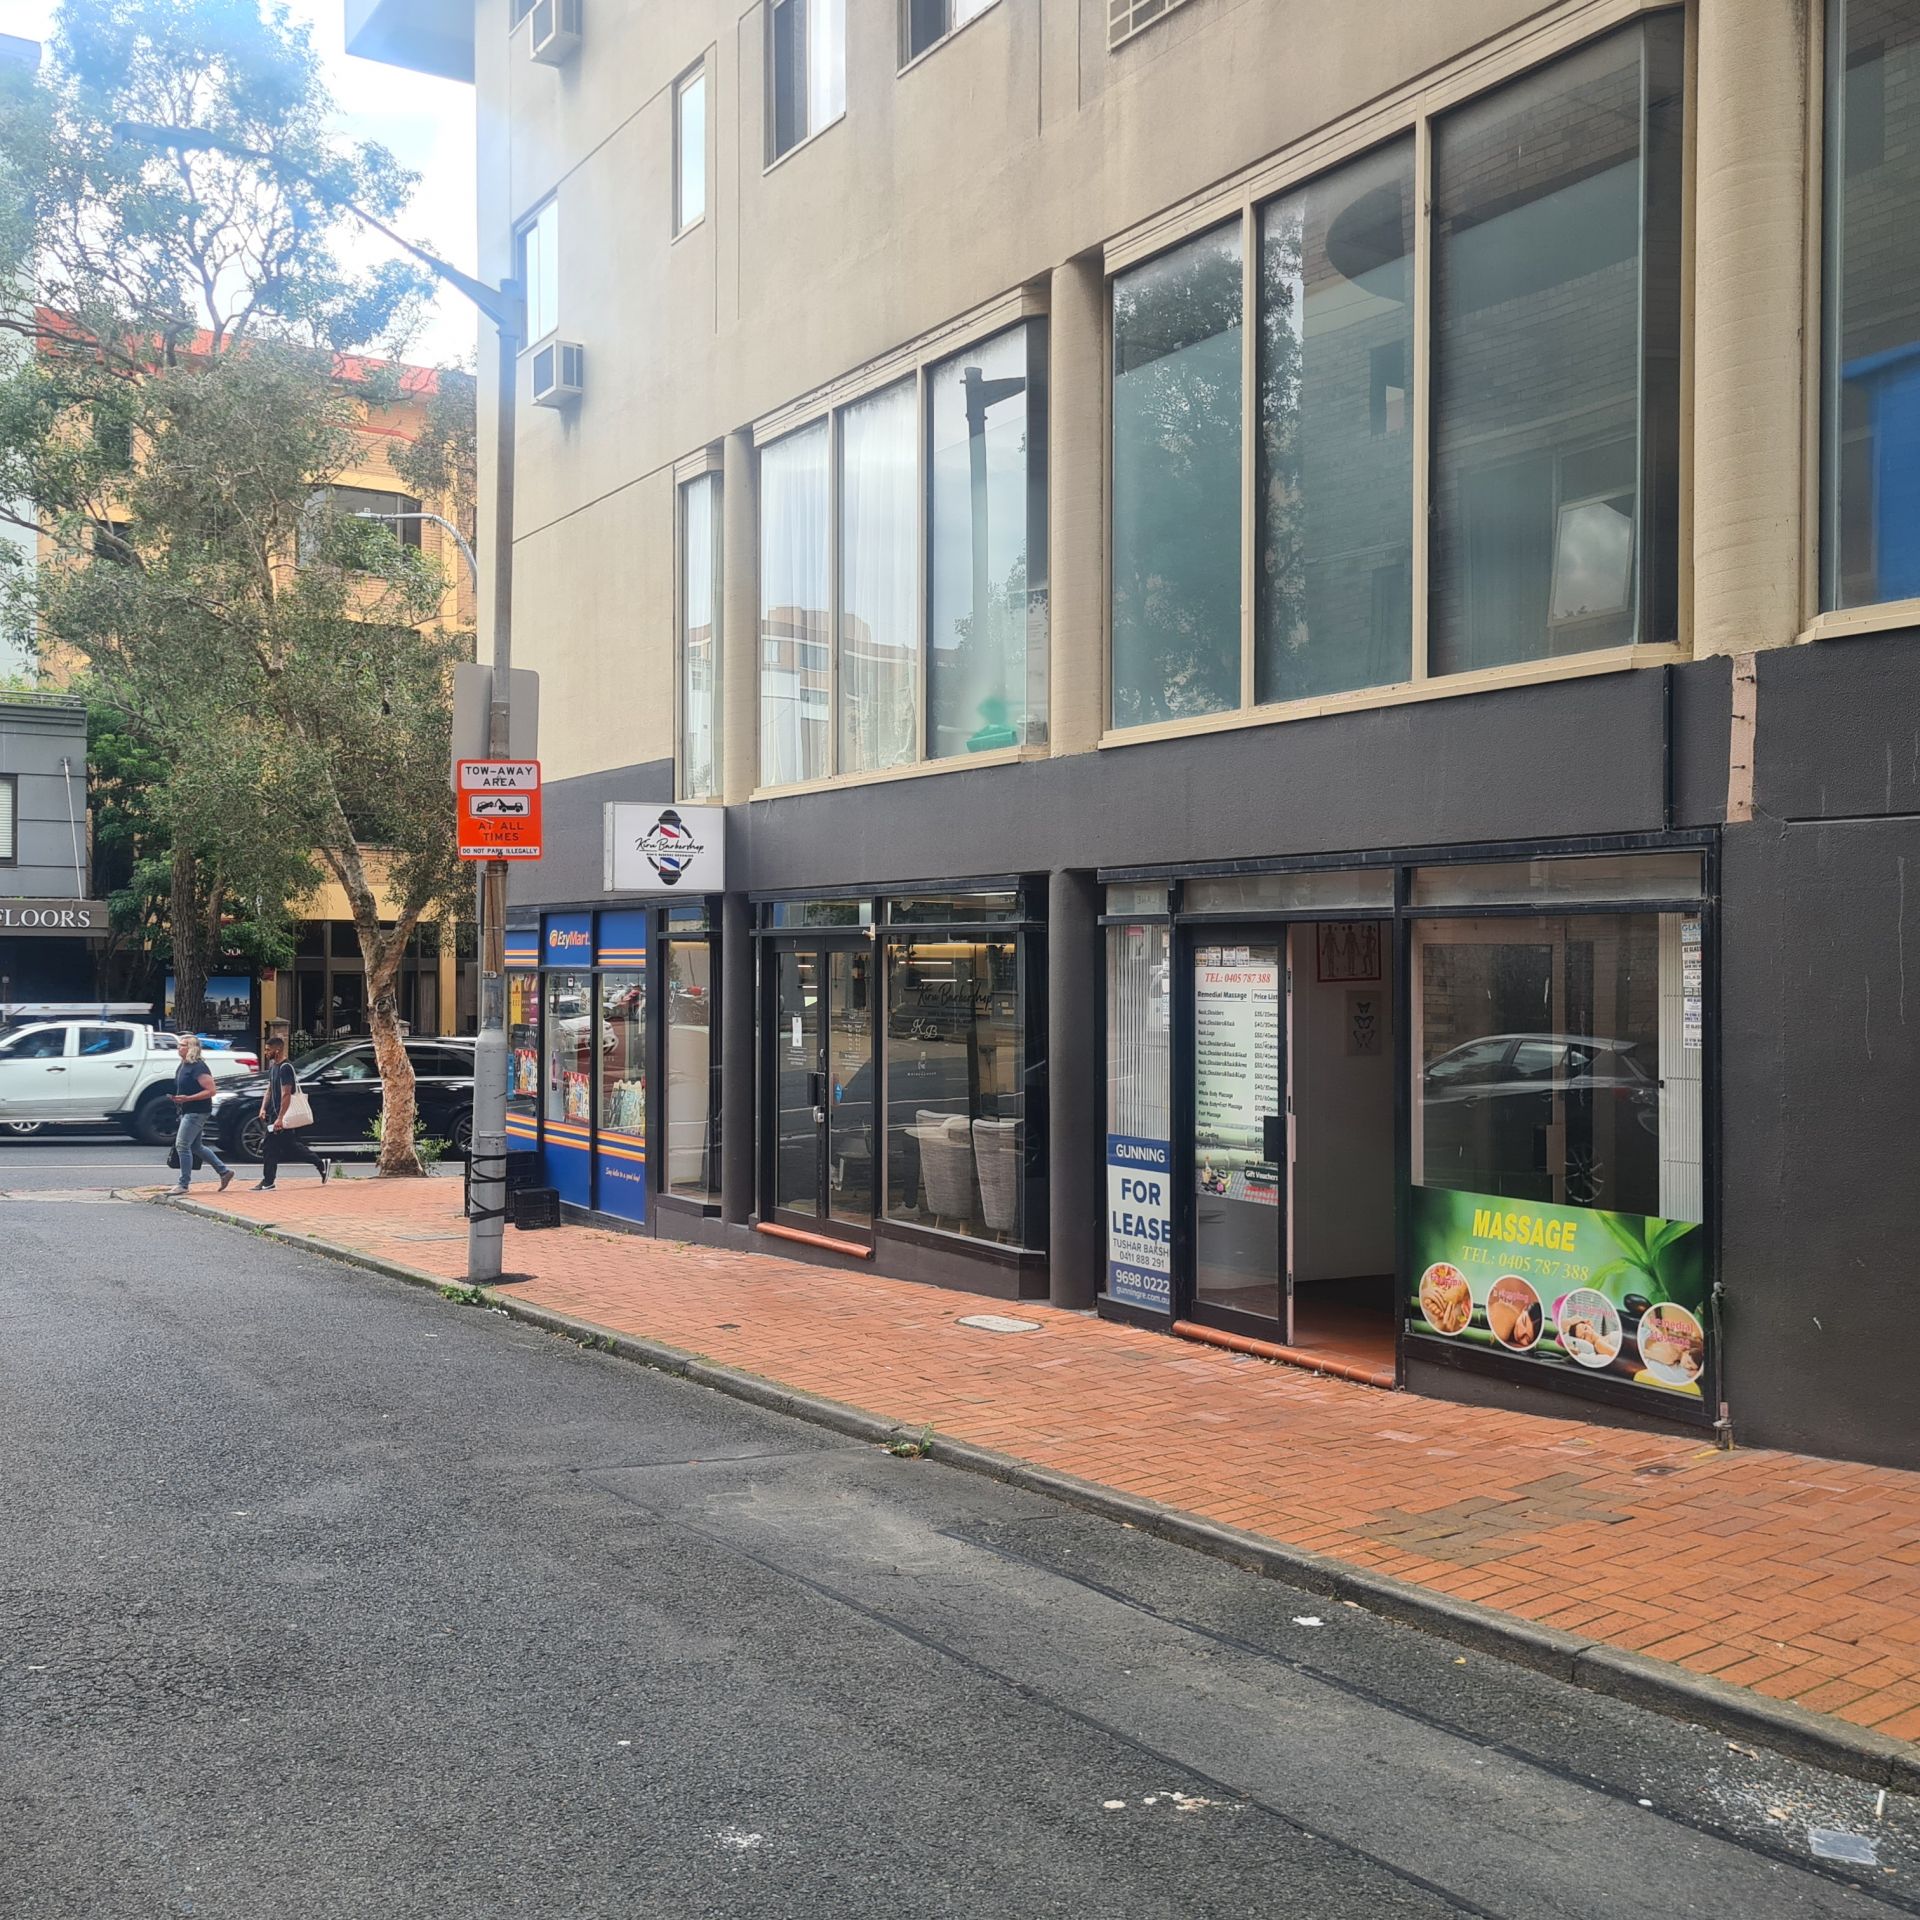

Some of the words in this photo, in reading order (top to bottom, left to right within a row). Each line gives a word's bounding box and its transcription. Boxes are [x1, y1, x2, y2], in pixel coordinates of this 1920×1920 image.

[465, 766, 533, 775] TOW-AWAY
[483, 778, 517, 787] AREA
[478, 821, 494, 830] AT
[500, 822, 524, 831] ALL
[483, 832, 520, 841] TIMES
[657, 838, 704, 854] Barbershop
[0, 908, 91, 928] LOORS
[1205, 973, 1223, 982] TEL:
[1224, 973, 1241, 983] 0405
[1243, 974, 1256, 983] 787
[1257, 973, 1271, 983] 388
[1223, 991, 1248, 1000] Massage
[1115, 1144, 1166, 1163] GUNNING
[1121, 1178, 1161, 1206] FOR
[1112, 1210, 1170, 1243] LEASE
[1472, 1208, 1577, 1252] MASSAGE
[1113, 1238, 1142, 1251] TUSHAR
[1120, 1250, 1135, 1262] 0411
[1136, 1254, 1150, 1265] 888
[1152, 1258, 1165, 1268] 291
[1461, 1245, 1495, 1265] TEL:
[1498, 1252, 1532, 1272] 0405
[1534, 1258, 1560, 1277] 787
[1561, 1263, 1589, 1282] 388
[1116, 1269, 1142, 1288] 9698
[1143, 1276, 1170, 1294] 0222
[1116, 1286, 1170, 1305] gunningre.com.au
